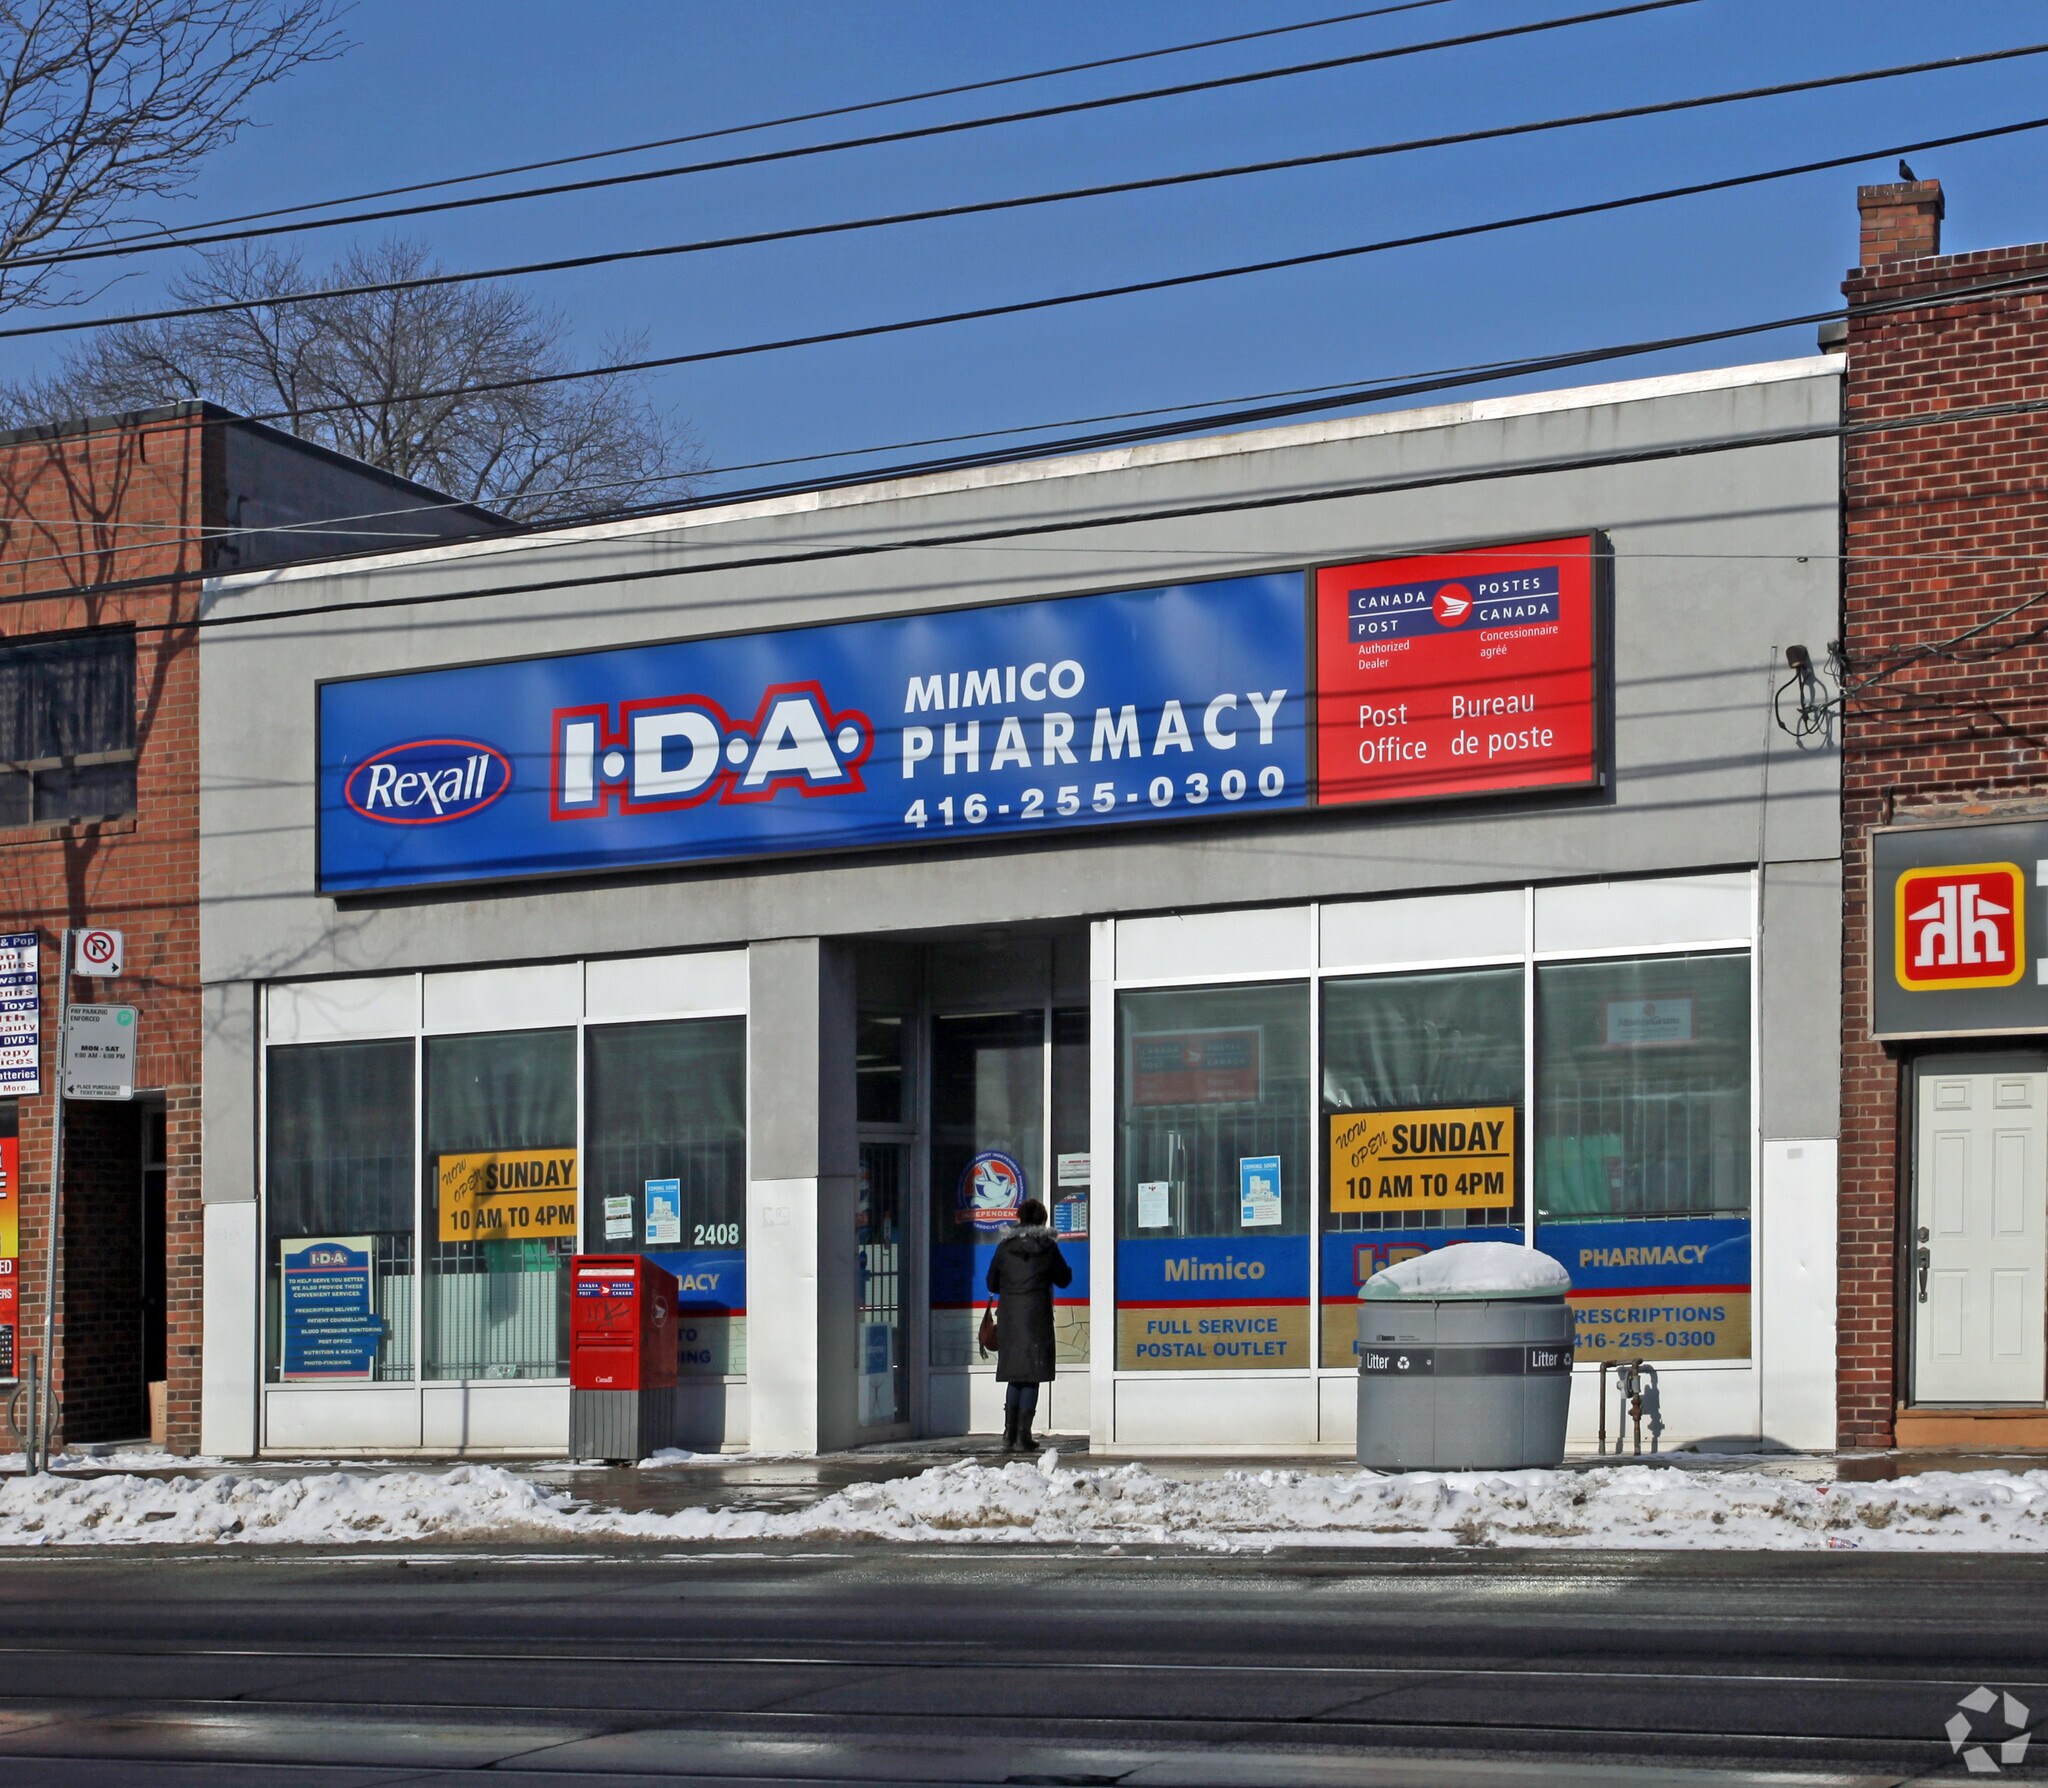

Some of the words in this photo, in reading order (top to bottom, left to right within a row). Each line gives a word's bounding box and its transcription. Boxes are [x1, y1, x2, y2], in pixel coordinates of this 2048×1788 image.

[1479, 577, 1540, 595] POSTES
[1358, 591, 1425, 609] CANADA
[1480, 603, 1550, 621] CANADA
[1358, 620, 1399, 635] POST
[1480, 624, 1558, 642] Concessionnaire
[1358, 640, 1410, 655] Authorized
[1480, 644, 1507, 659] agréé
[1358, 658, 1389, 670] Dealer
[904, 659, 1085, 714] MIMICO
[1359, 703, 1408, 728] Post
[1452, 693, 1534, 719] Bureau
[902, 689, 1288, 779] PHARMACY
[1451, 730, 1479, 755] de
[1488, 726, 1553, 759] poste
[1359, 738, 1427, 765] Office
[365, 754, 491, 815] Rexall
[904, 766, 1285, 829] 416-255-0300
[13, 937, 34, 946] Pop
[2, 1001, 35, 1011] Toys
[4, 1035, 35, 1045] DVD's
[1392, 1121, 1505, 1154] SUNDAY
[485, 1158, 575, 1190] SUNDAY
[1346, 1176, 1371, 1199] 10
[1378, 1174, 1413, 1198] AM
[1420, 1173, 1448, 1196] TO
[1455, 1172, 1504, 1195] 4PM
[450, 1210, 470, 1230] 10
[475, 1208, 502, 1230] AM
[508, 1206, 529, 1227] TO
[535, 1204, 575, 1226] 4PM
[694, 1223, 740, 1246] 2408
[1579, 1245, 1709, 1268] PHARMACY
[1164, 1256, 1265, 1281] Mimico
[1147, 1319, 1192, 1334] FULL
[1199, 1318, 1278, 1334] SERVICE
[1136, 1342, 1207, 1358] POSTAL
[1213, 1341, 1287, 1356] OUTLET
[1532, 1351, 1558, 1367] Litter
[1366, 1352, 1390, 1369] Litter
